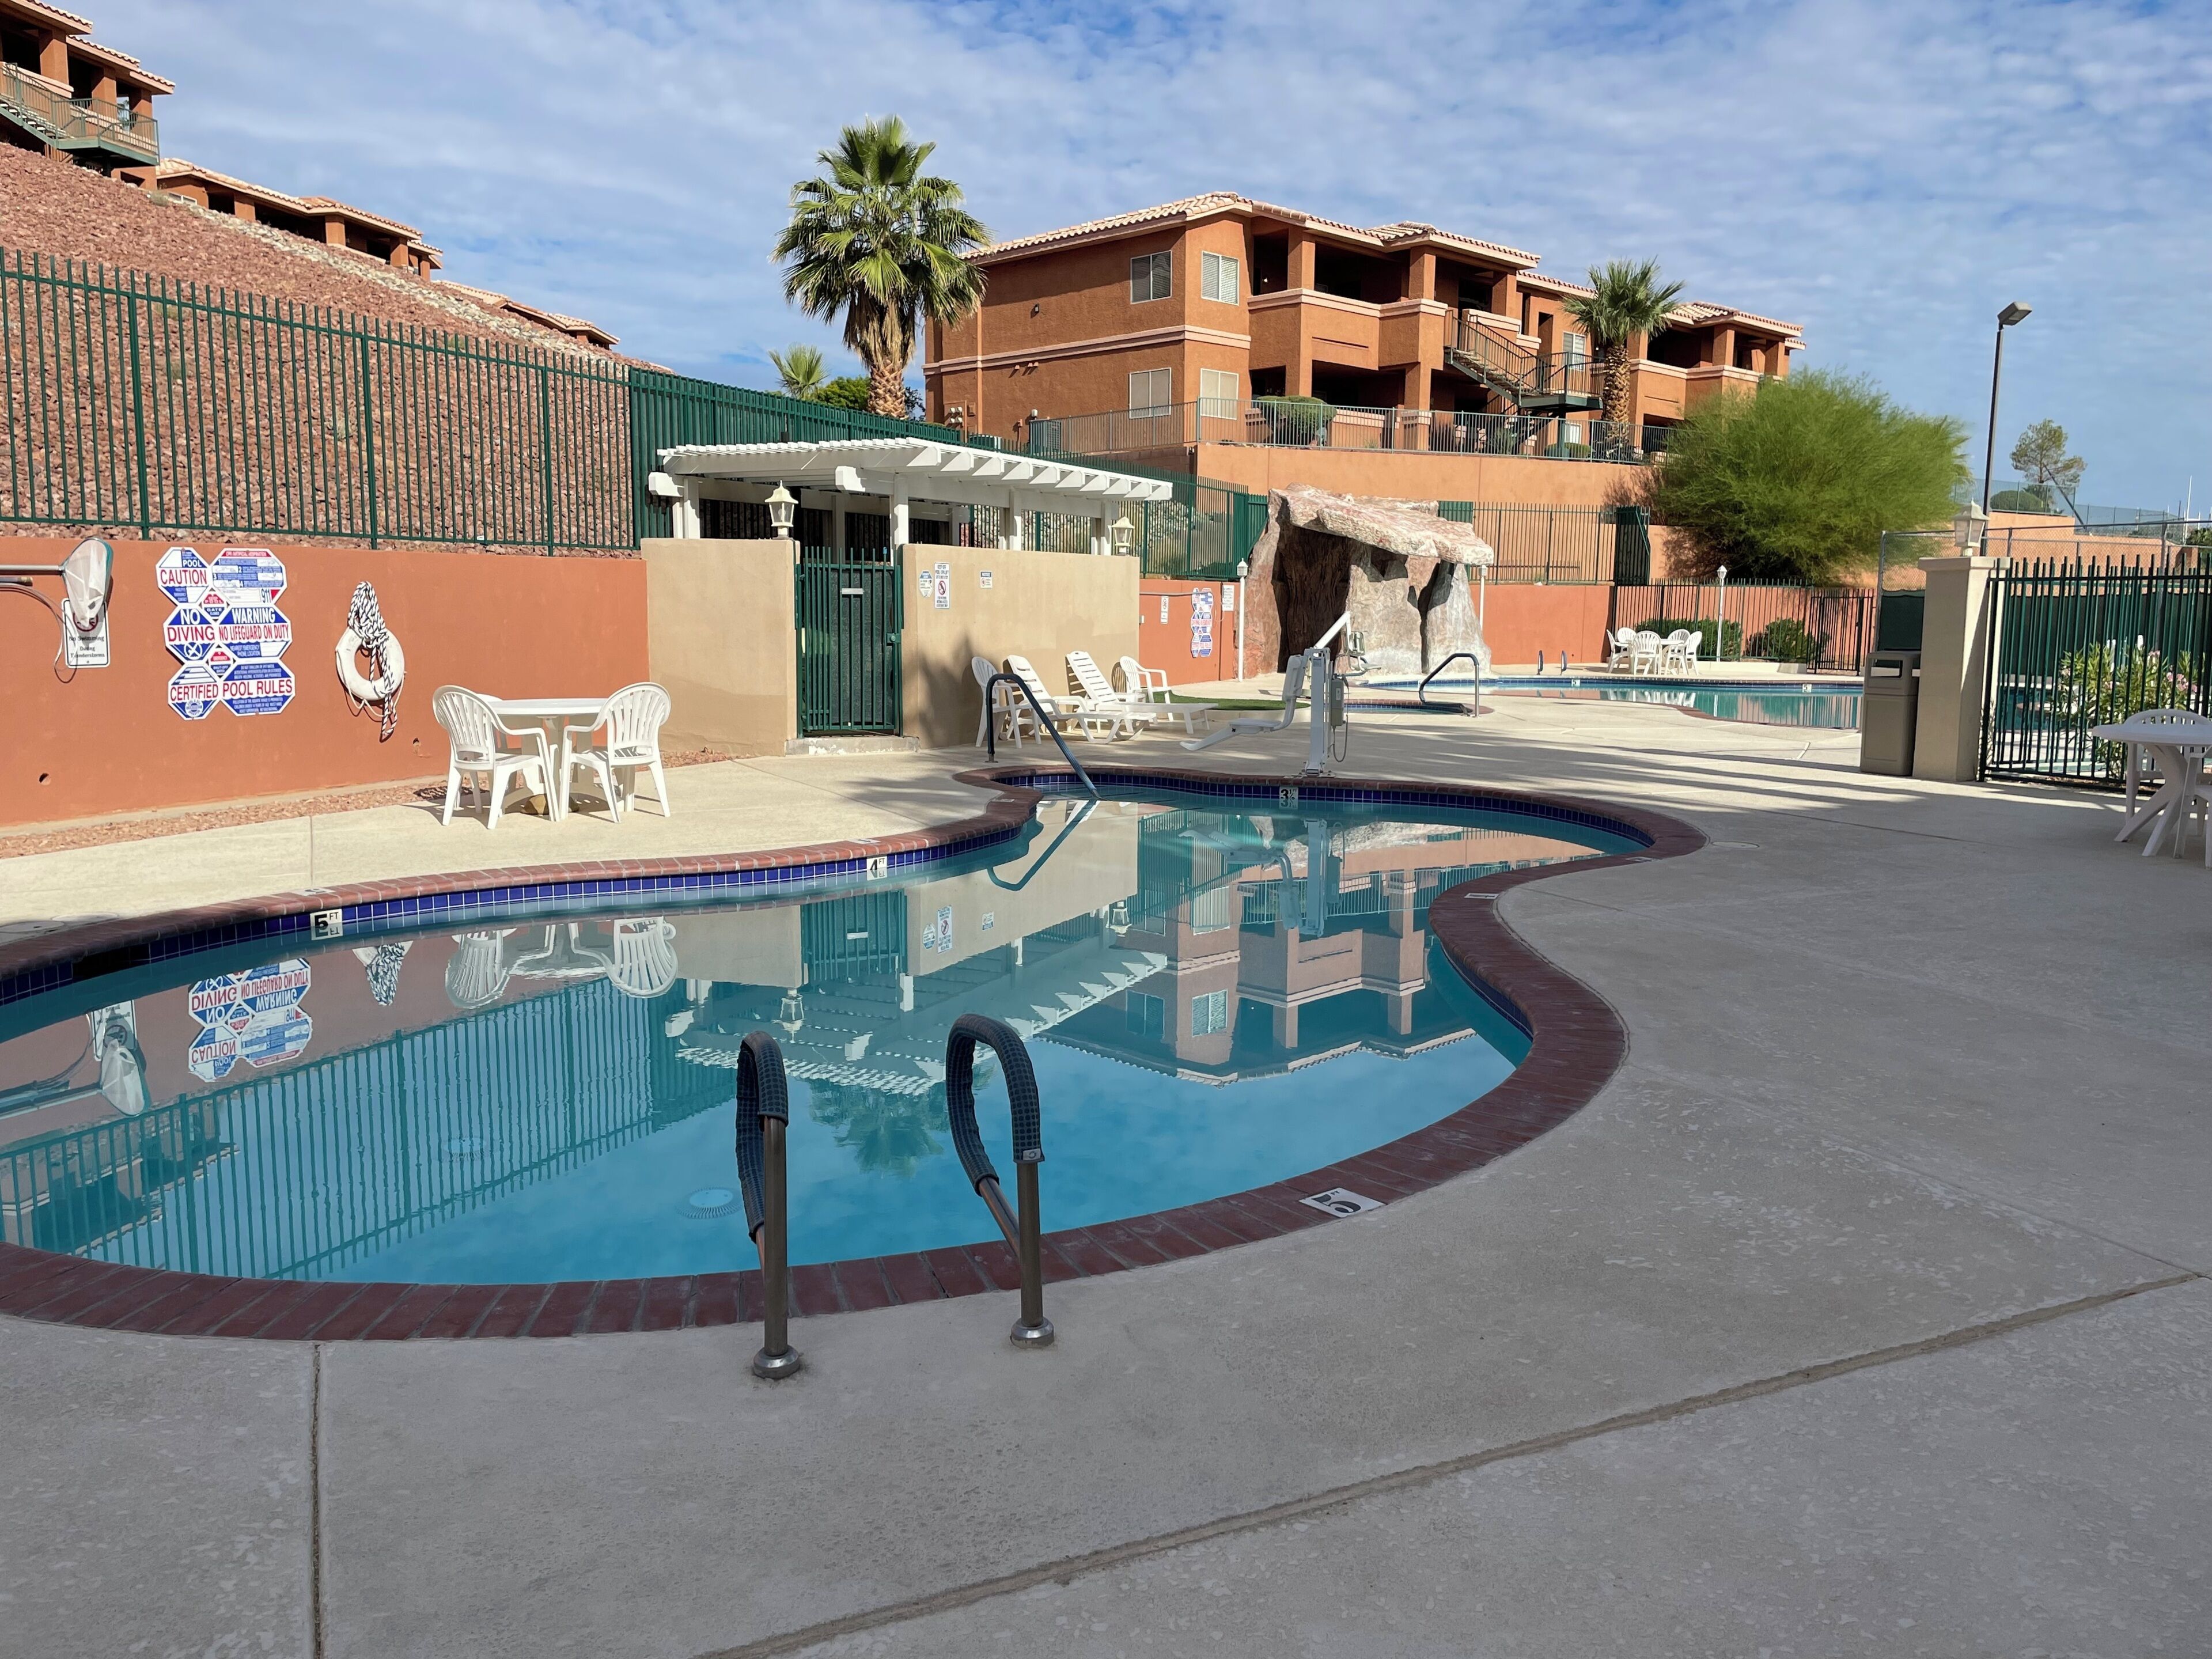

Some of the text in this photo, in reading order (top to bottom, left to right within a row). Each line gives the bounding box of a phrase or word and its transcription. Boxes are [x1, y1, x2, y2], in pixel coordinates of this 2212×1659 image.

[183, 559, 202, 567] POOL
[160, 569, 207, 585] CAUTION
[261, 588, 271, 603] 911
[180, 609, 200, 625] NO
[232, 608, 275, 624] WARNING
[167, 626, 215, 642] DIVING
[219, 624, 289, 641] NO LIFEGUARD ON DUTY
[170, 684, 218, 701] CERTIFIED
[222, 679, 293, 697] POOL RULES
[1281, 789, 1289, 800] 3
[314, 911, 339, 927] 5 FT
[1311, 1194, 1361, 1214] 5
